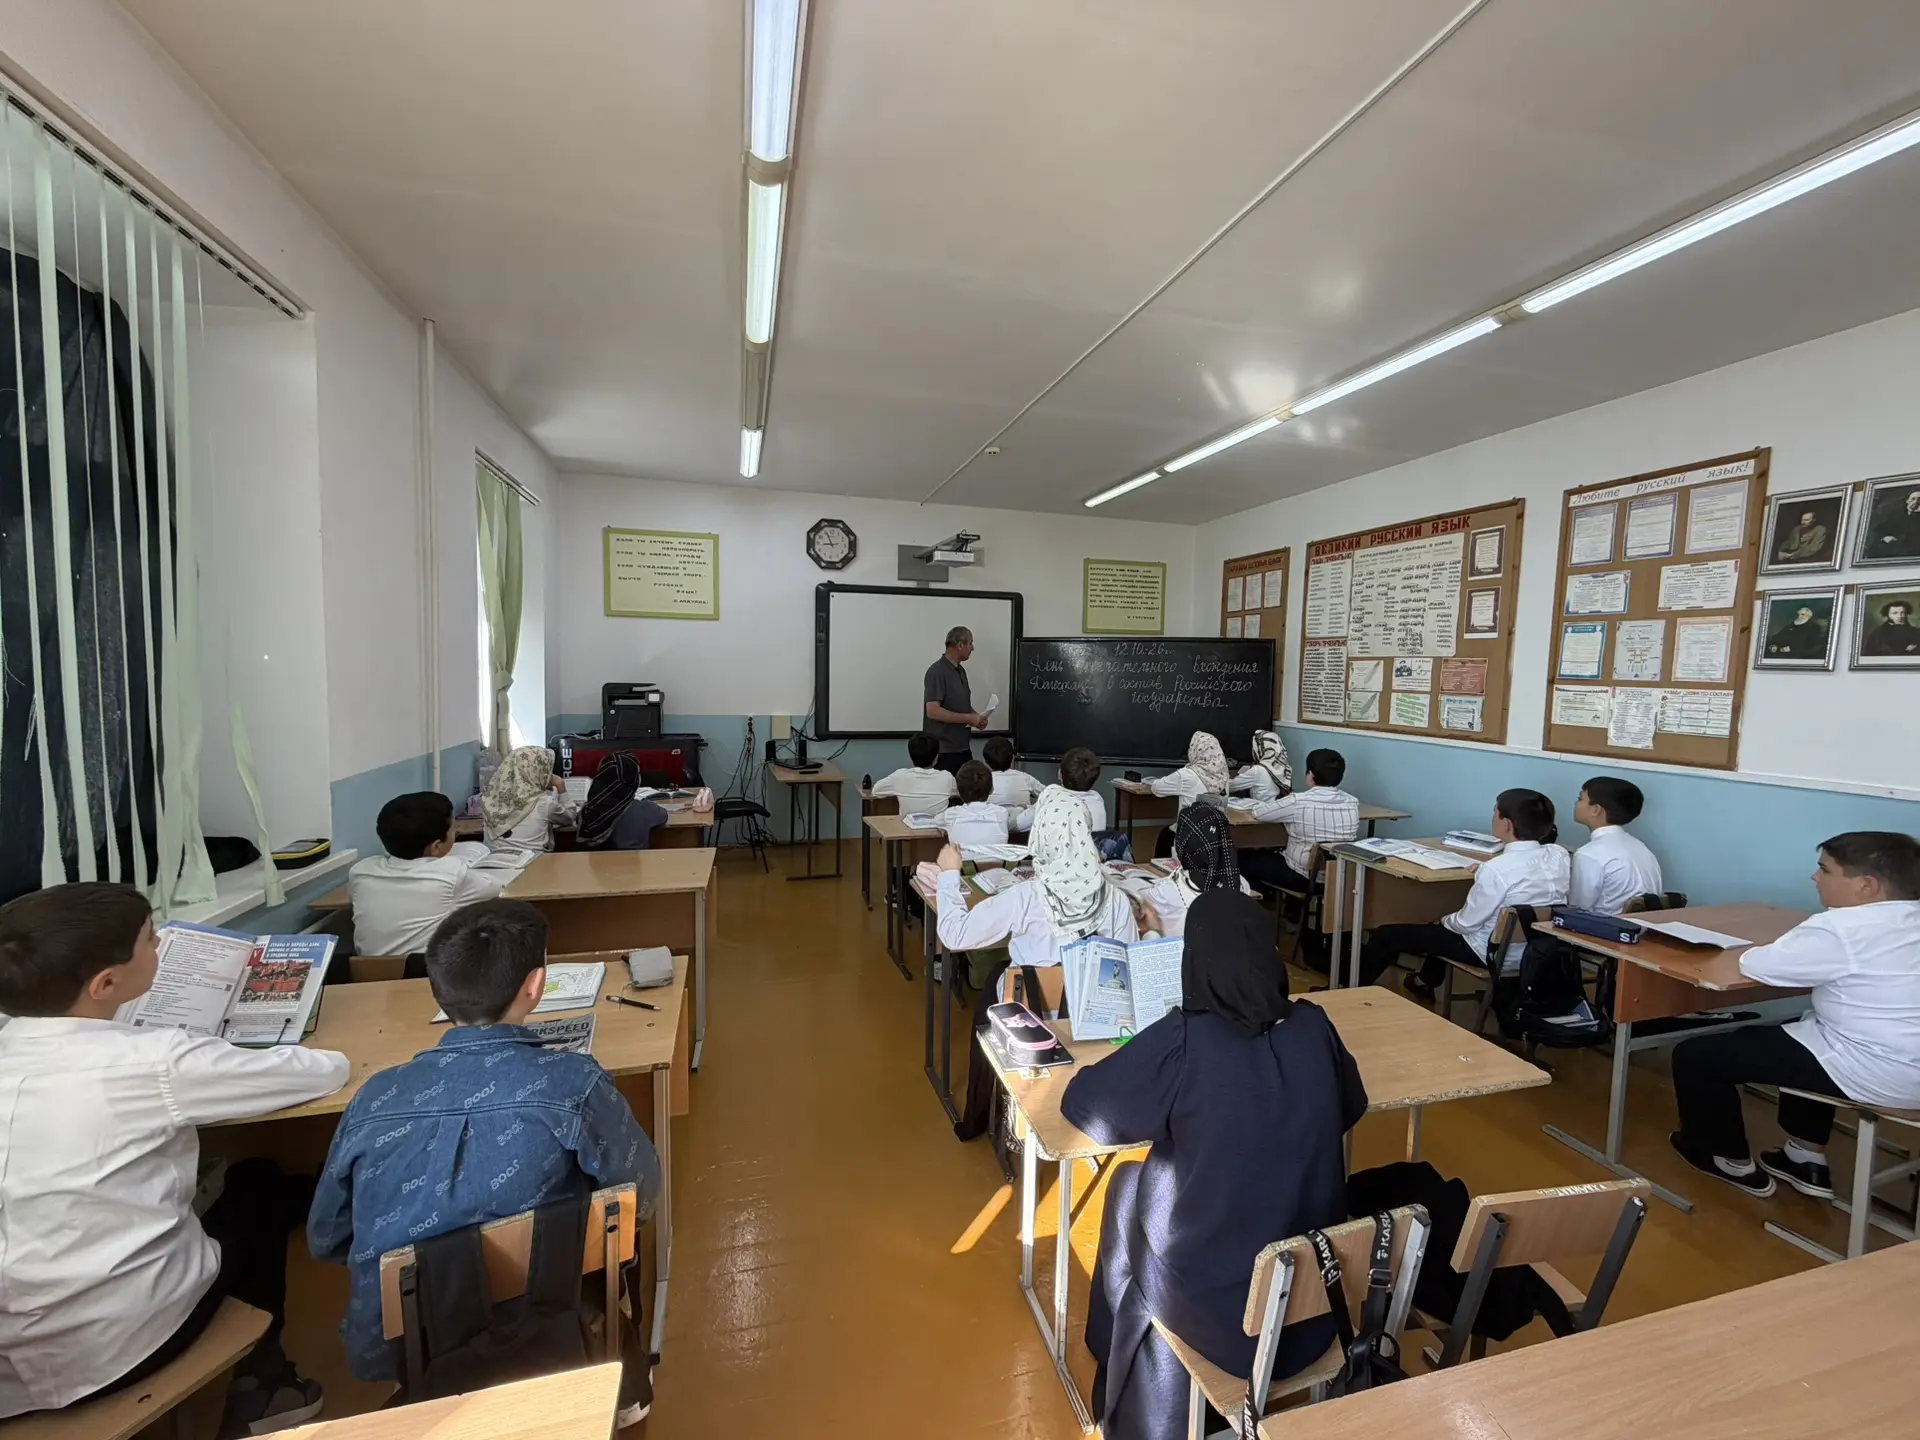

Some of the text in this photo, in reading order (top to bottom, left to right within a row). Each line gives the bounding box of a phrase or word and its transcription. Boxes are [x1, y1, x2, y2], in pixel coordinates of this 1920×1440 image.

[1572, 462, 1750, 504] Любите русский язык!
[1431, 515, 1470, 534] ЯЗЫК
[1174, 674, 1253, 692] Российского
[370, 1083, 398, 1112] BOOS
[463, 1081, 496, 1109] BOOS
[375, 1121, 414, 1148] BOOS
[490, 1159, 520, 1192] BOOS
[409, 1211, 439, 1237] BOOS
[1379, 1212, 1392, 1247] KARL
[355, 1245, 376, 1264] BOOS
